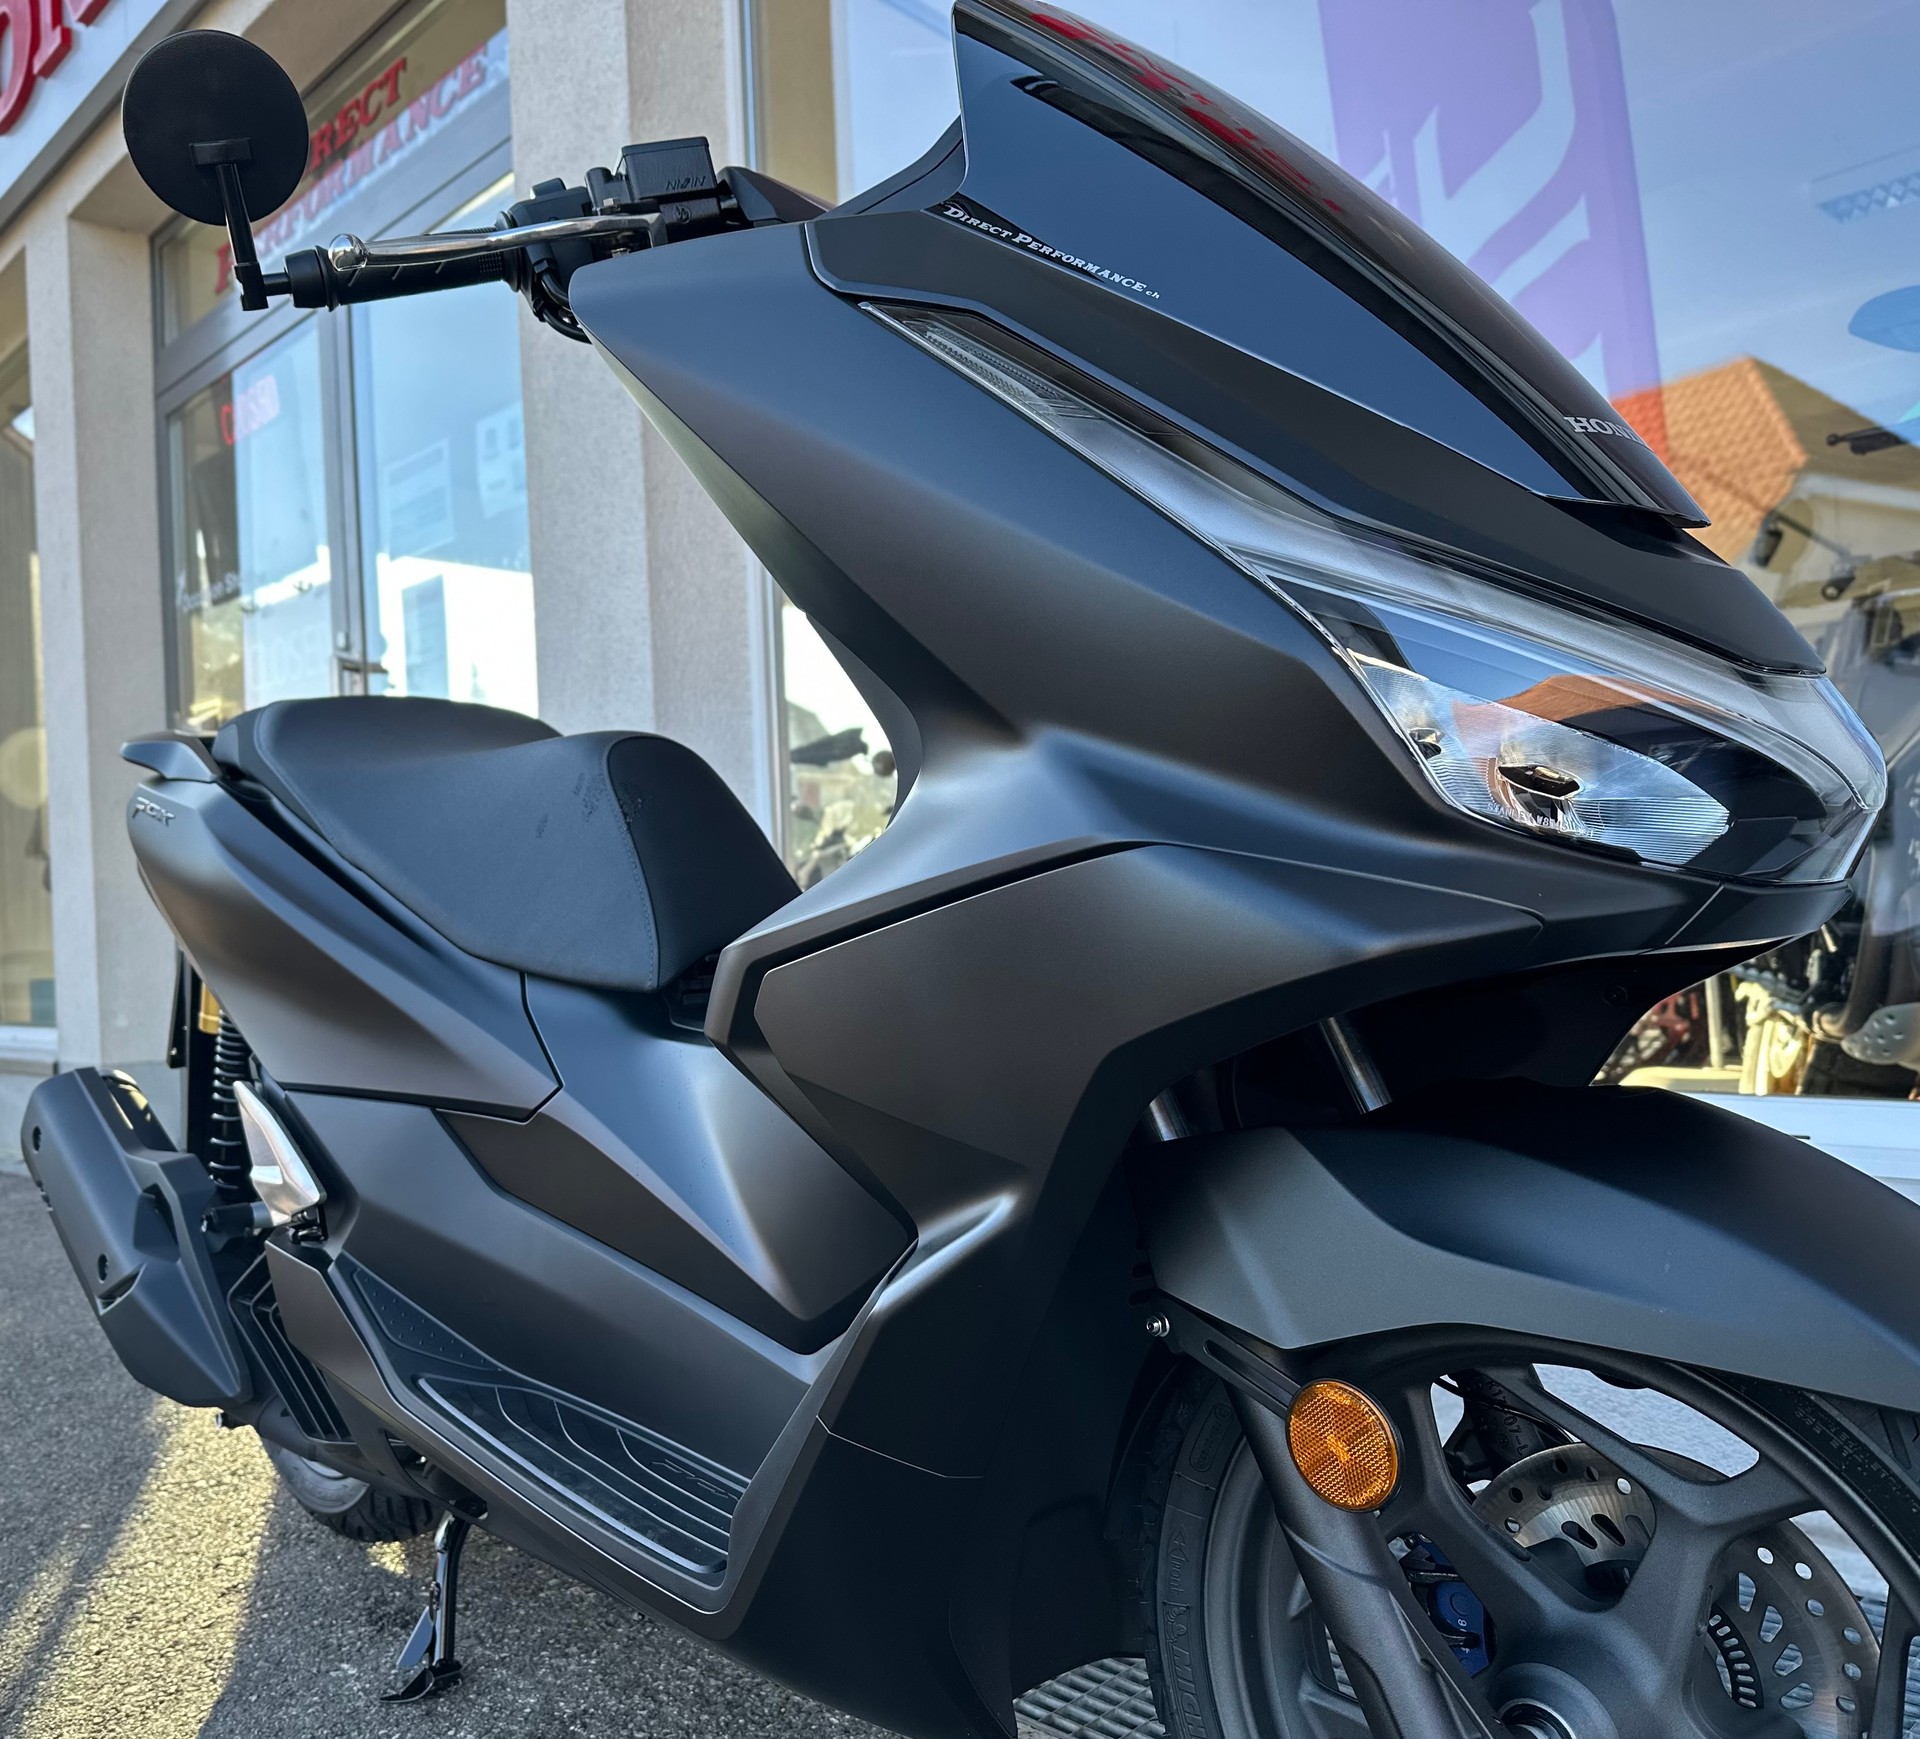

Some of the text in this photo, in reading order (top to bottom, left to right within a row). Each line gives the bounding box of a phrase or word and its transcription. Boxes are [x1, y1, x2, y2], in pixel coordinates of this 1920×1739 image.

[306, 56, 408, 176] RECT
[943, 205, 1013, 239] DIRECT
[1012, 232, 1148, 293] PERFORMANCE
[1172, 1645, 1209, 1739] MICH
